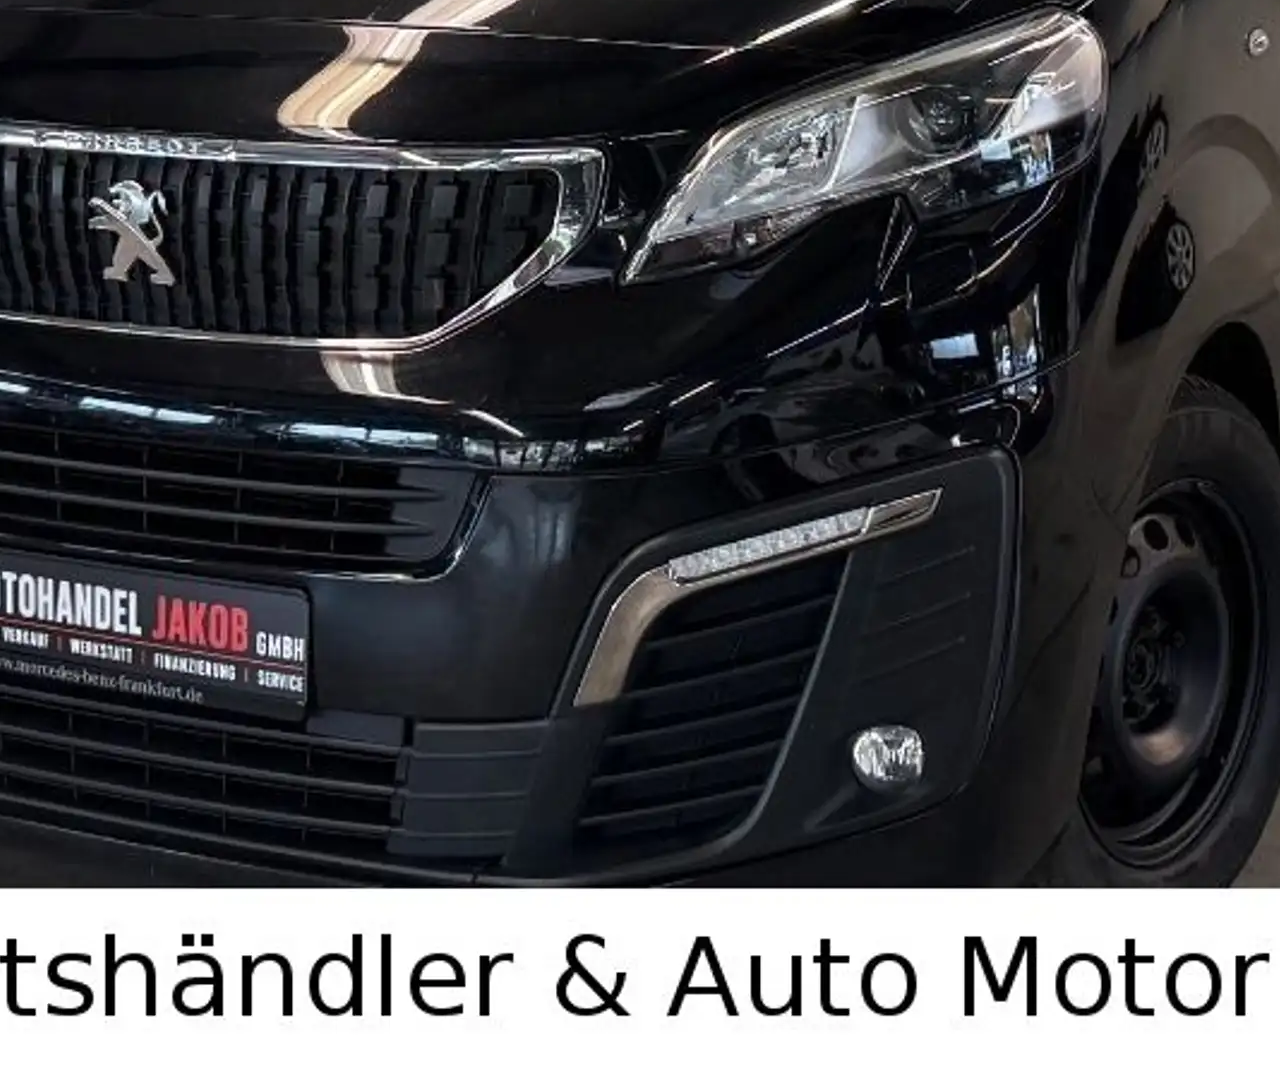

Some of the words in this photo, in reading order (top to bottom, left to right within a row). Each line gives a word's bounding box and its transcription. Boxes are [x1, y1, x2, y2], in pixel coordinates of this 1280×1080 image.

[152, 595, 249, 653] JAKOB
[255, 631, 305, 661] GMBH
[256, 669, 304, 692] SERVICE
